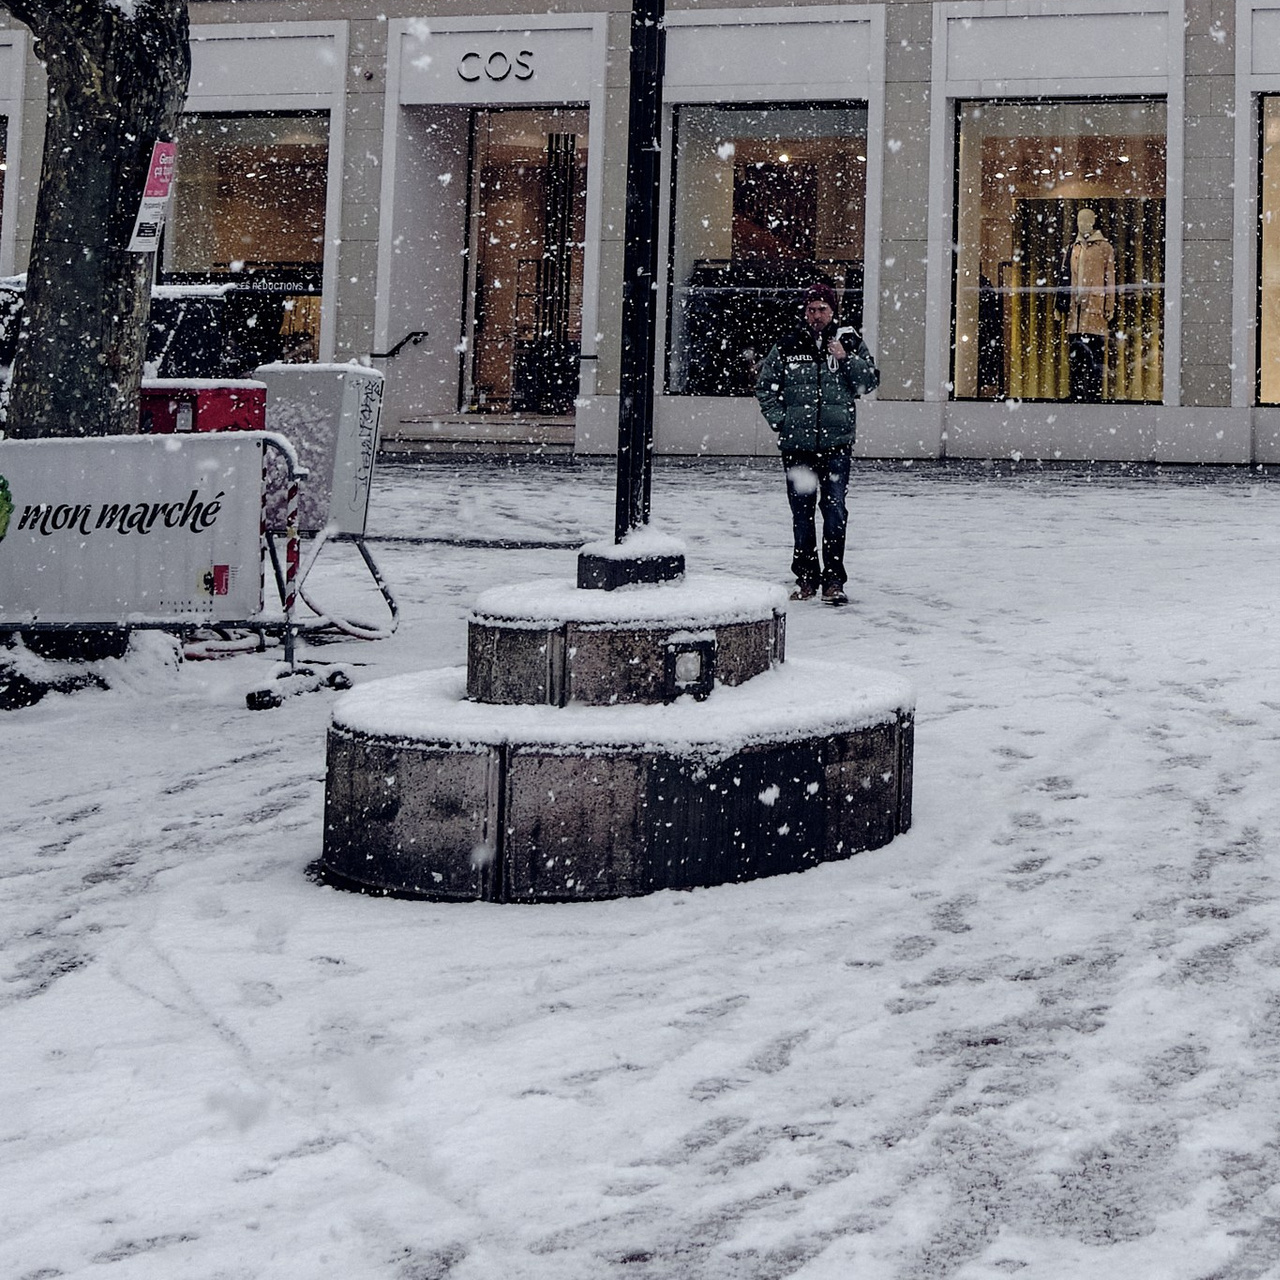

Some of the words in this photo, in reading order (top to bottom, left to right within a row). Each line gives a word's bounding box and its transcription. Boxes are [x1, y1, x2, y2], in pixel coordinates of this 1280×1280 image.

[457, 50, 534, 82] COS
[17, 503, 92, 536] mon
[95, 489, 225, 535] marché
